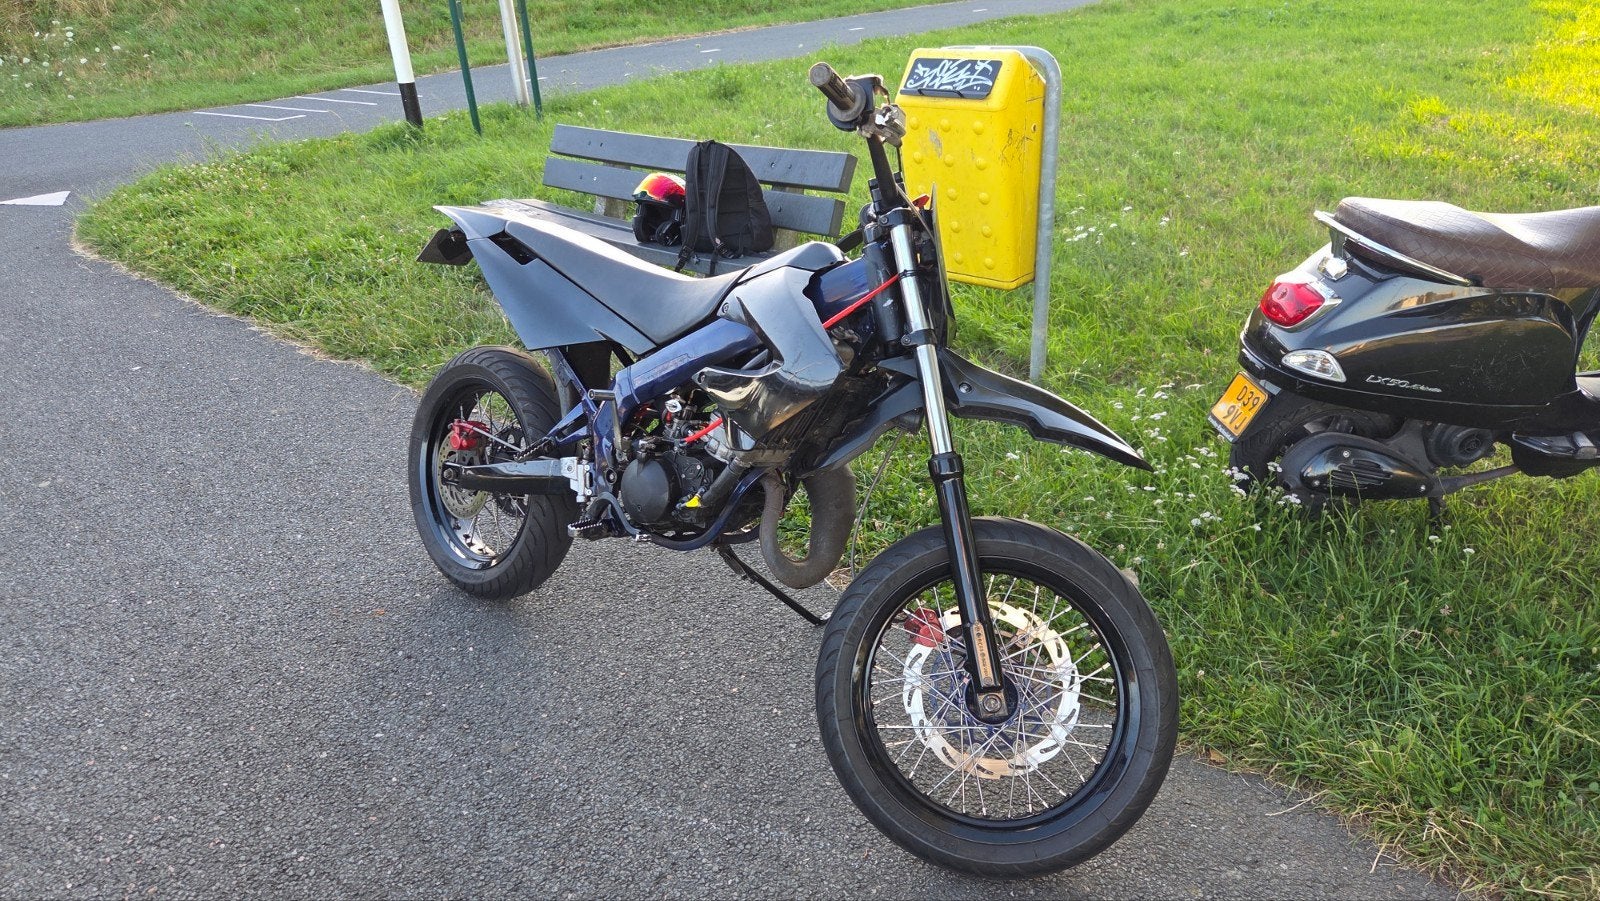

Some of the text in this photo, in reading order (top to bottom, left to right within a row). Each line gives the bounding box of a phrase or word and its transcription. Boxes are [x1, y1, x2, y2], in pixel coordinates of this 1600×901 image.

[1366, 374, 1409, 388] LX50
[1236, 385, 1261, 412] D39
[1222, 404, 1248, 430] 9VJ
